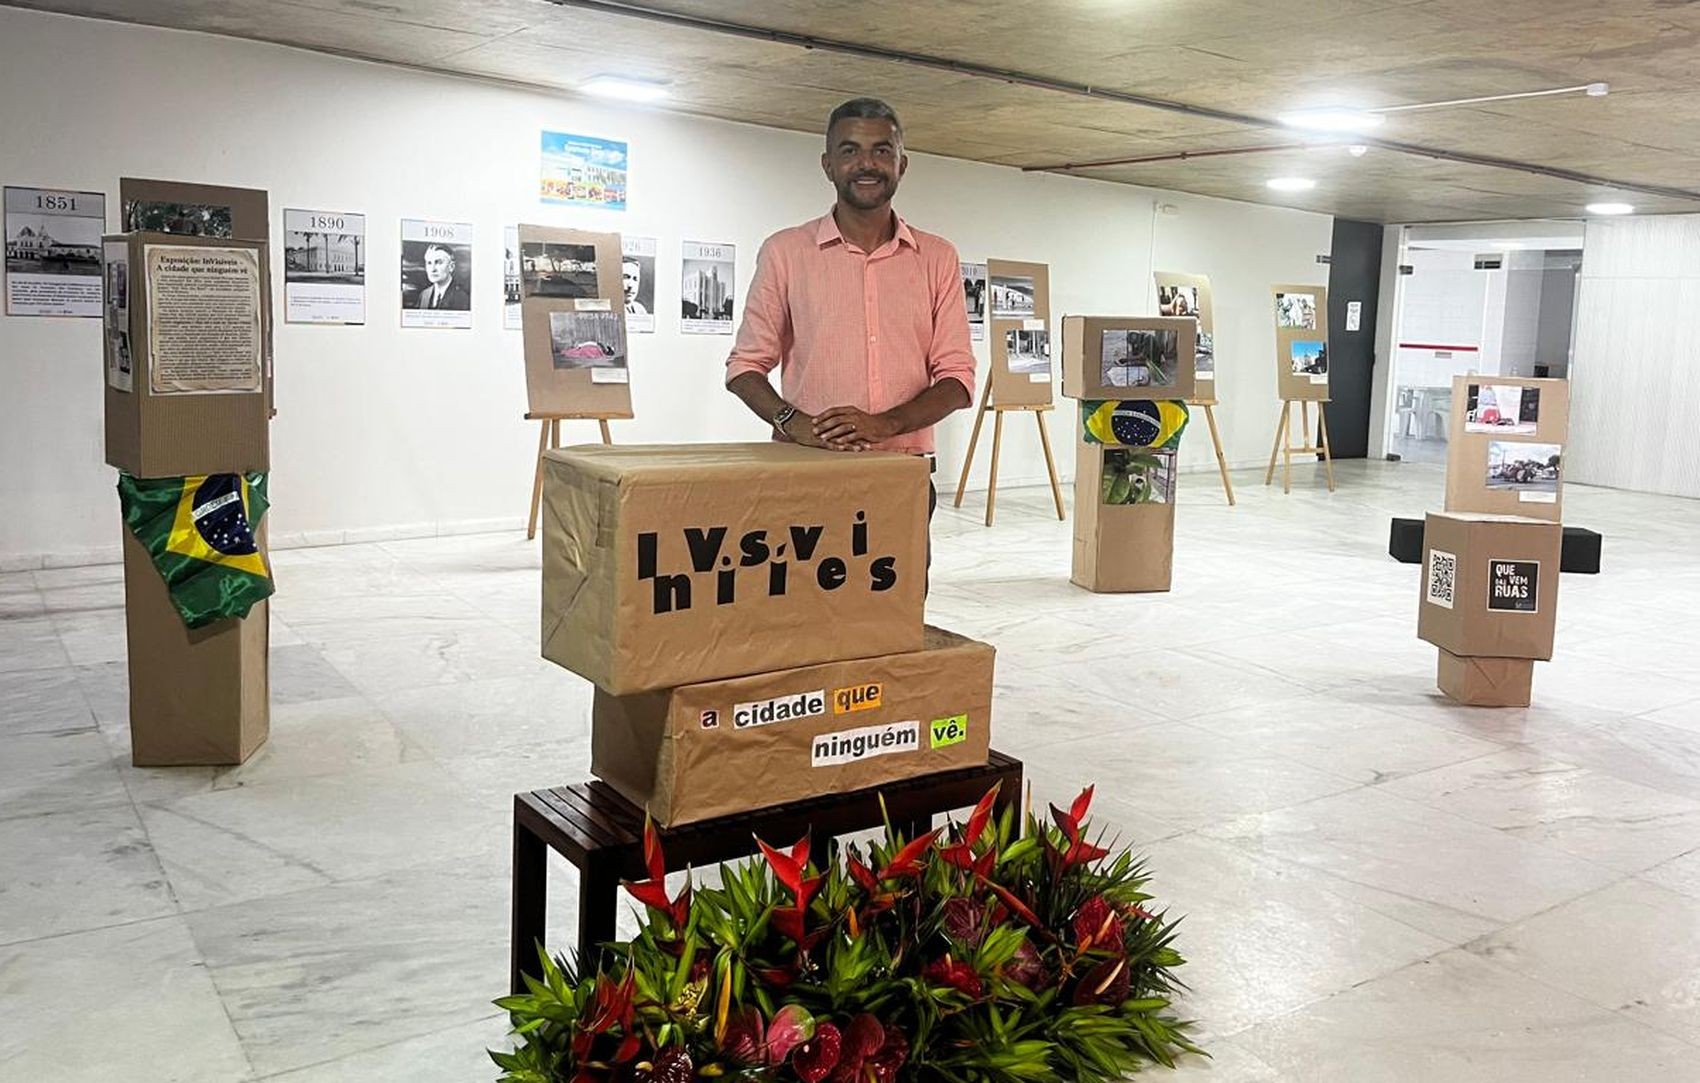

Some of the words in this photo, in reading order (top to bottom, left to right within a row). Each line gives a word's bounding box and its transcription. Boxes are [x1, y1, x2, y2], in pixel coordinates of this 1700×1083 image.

[36, 195, 76, 211] 1851
[310, 216, 345, 230] 1890
[424, 226, 455, 239] 1908
[699, 246, 722, 258] 1936
[1495, 564, 1516, 577] QUE
[1509, 575, 1529, 585] VEM
[1494, 585, 1529, 598] RUAS
[701, 709, 718, 728] a
[734, 694, 824, 728] cidade
[836, 684, 880, 712] que
[814, 725, 917, 759] ninguém
[933, 720, 965, 740] vê.
